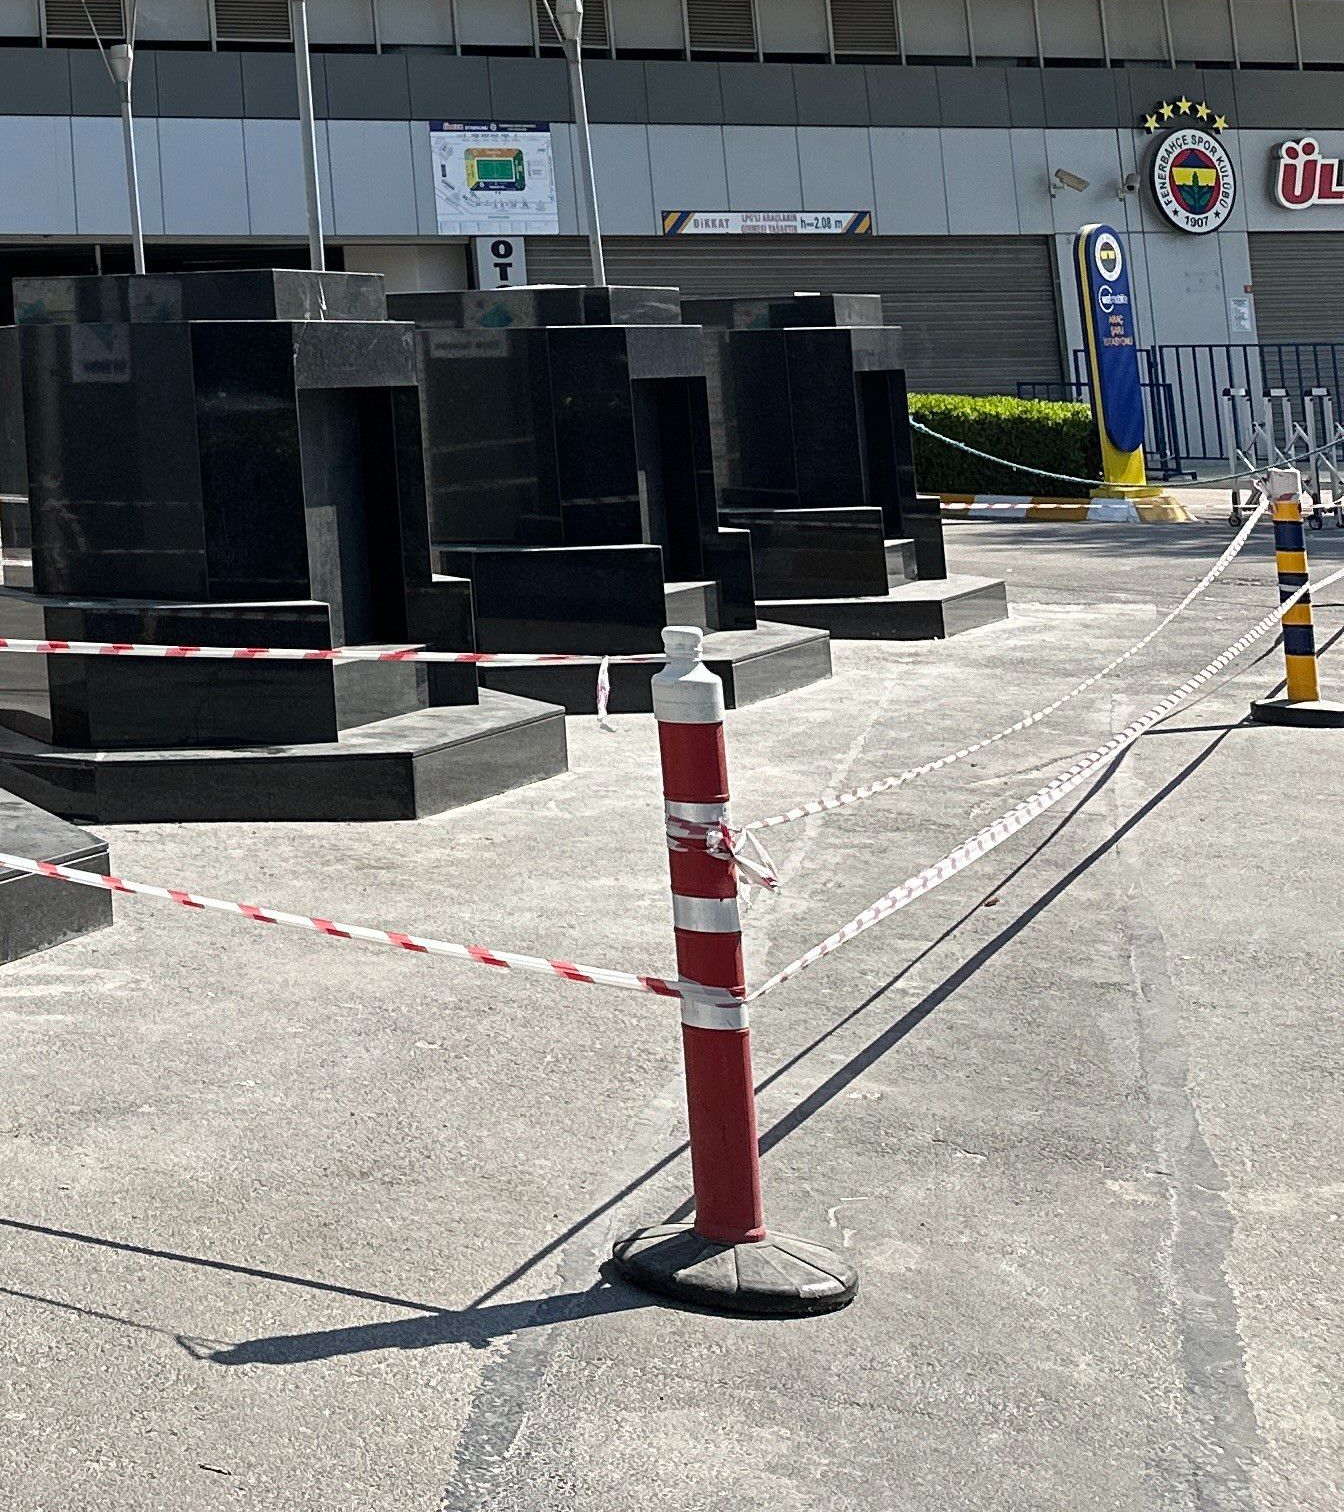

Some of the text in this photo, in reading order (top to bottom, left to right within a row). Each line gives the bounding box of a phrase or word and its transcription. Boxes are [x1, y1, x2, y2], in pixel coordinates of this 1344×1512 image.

[1158, 134, 1190, 207] FENERBAHÇE
[1190, 134, 1218, 158] SPOR
[1184, 215, 1209, 228] 1907
[491, 240, 513, 289] OT
